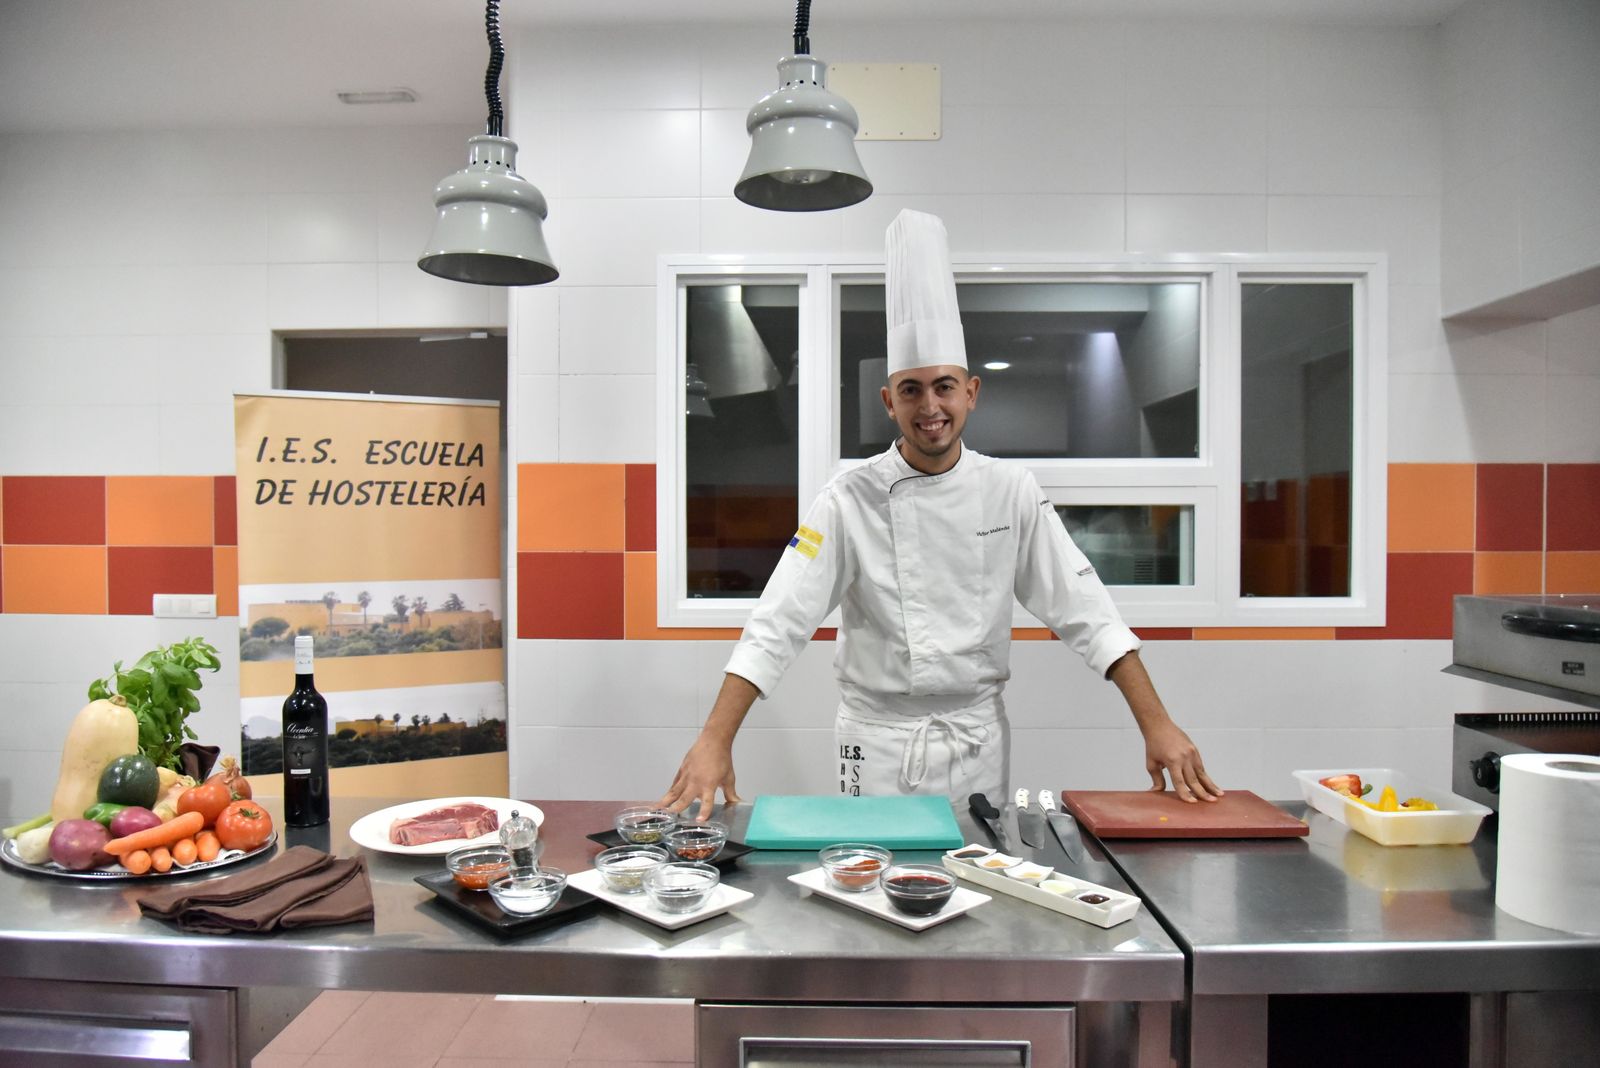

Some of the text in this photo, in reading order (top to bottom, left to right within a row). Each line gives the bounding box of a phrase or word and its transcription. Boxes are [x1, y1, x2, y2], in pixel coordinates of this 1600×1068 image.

[256, 436, 485, 467] I.E.S. ESCUELA
[255, 475, 486, 507] DE HOSTELERÍA
[840, 744, 865, 761] I.E.S.
